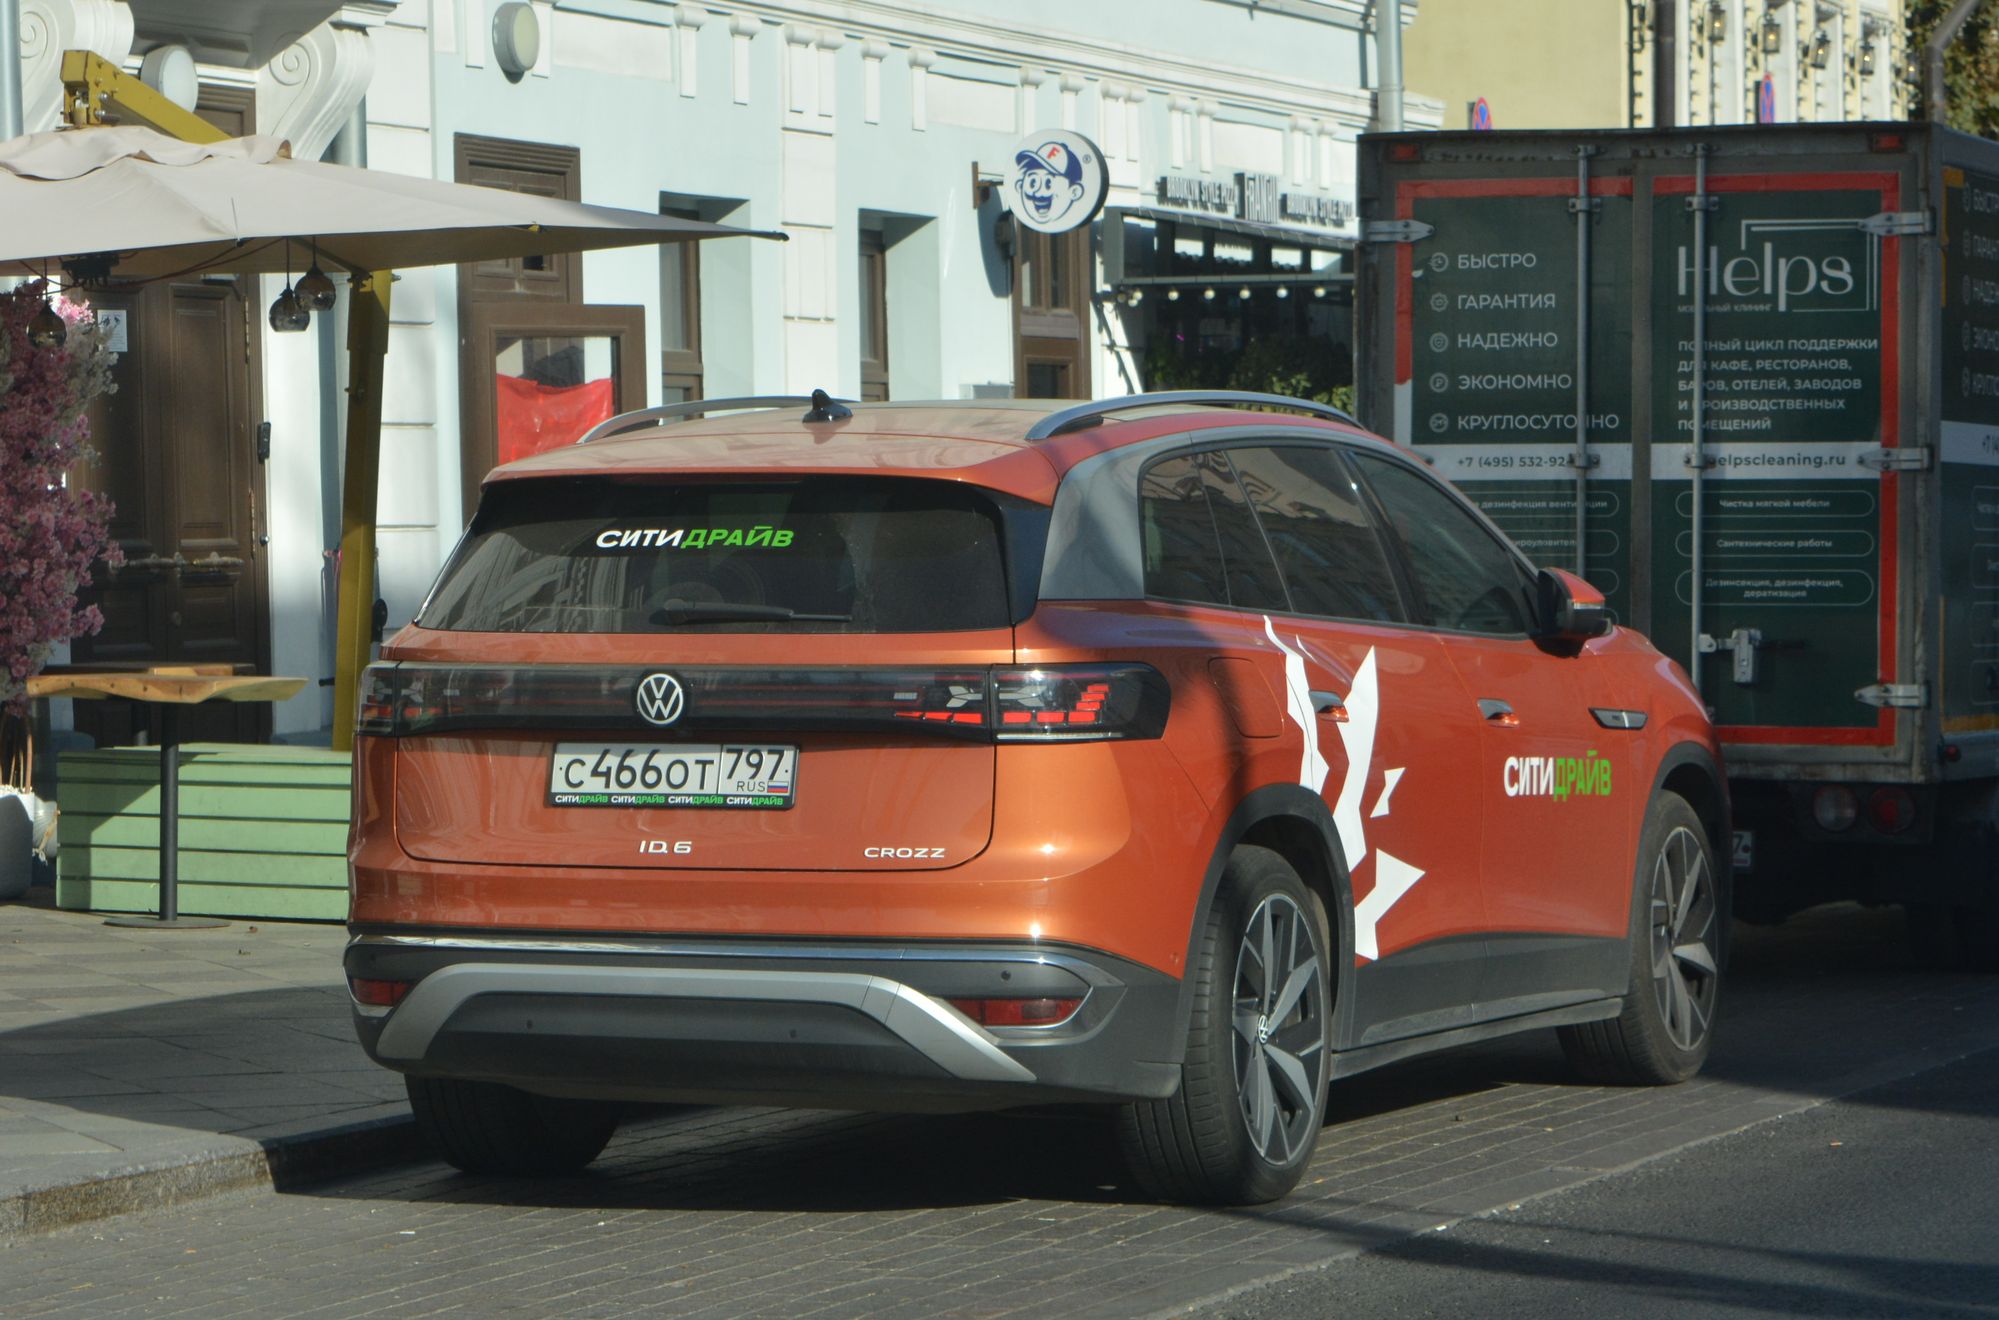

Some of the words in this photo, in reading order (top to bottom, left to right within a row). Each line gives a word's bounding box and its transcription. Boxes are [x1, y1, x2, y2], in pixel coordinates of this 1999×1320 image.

[1046, 146, 1061, 160] F
[1201, 181, 1221, 204] STYLE
[1458, 253, 1537, 269] БЫСТРО
[1678, 242, 1853, 312] Helps
[1457, 293, 1556, 310] ГАРАНТИЯ
[1457, 332, 1558, 350] НАДЕЖНО
[1745, 340, 1784, 352] ЦИКЛ
[1788, 339, 1878, 351] ПОДДЕРЖКИ
[1677, 361, 1706, 372] ДЛ
[1711, 360, 1752, 372] КАФЕ,
[1756, 359, 1852, 371] РЕСТОРАНОВ,
[1457, 374, 1572, 390] ЭКОНОМНО
[1678, 380, 1729, 392] БАОВ,
[1732, 377, 1791, 392] ОТЕЛЕЙ,
[1794, 378, 1862, 391] ЗАВОДОВ
[1678, 400, 1688, 411] И
[1457, 414, 1620, 430] КРУГЛОСУТОНО
[1457, 457, 1473, 468] +7
[1478, 456, 1514, 469] (495)
[1718, 453, 1846, 468] elpscleaning.ru
[1719, 499, 1754, 508] Чистка
[1756, 499, 1791, 508] мягкой
[1793, 499, 1830, 508] мебели
[596, 525, 794, 549] СИТИДРАЙВ
[1716, 538, 1794, 548] Сантехнические
[1797, 538, 1832, 549] работы
[726, 748, 785, 780] 797
[1503, 750, 1612, 801] СИТИДРАЙВ
[736, 781, 766, 792] RUS
[555, 794, 608, 804] СИТИДРАЙВ
[611, 794, 665, 804] СИТИДРАЙВ
[668, 795, 723, 804] СИТИДРАЙВ
[726, 796, 784, 806] СИТИДРАЙВ
[864, 847, 945, 859] CROZZ
